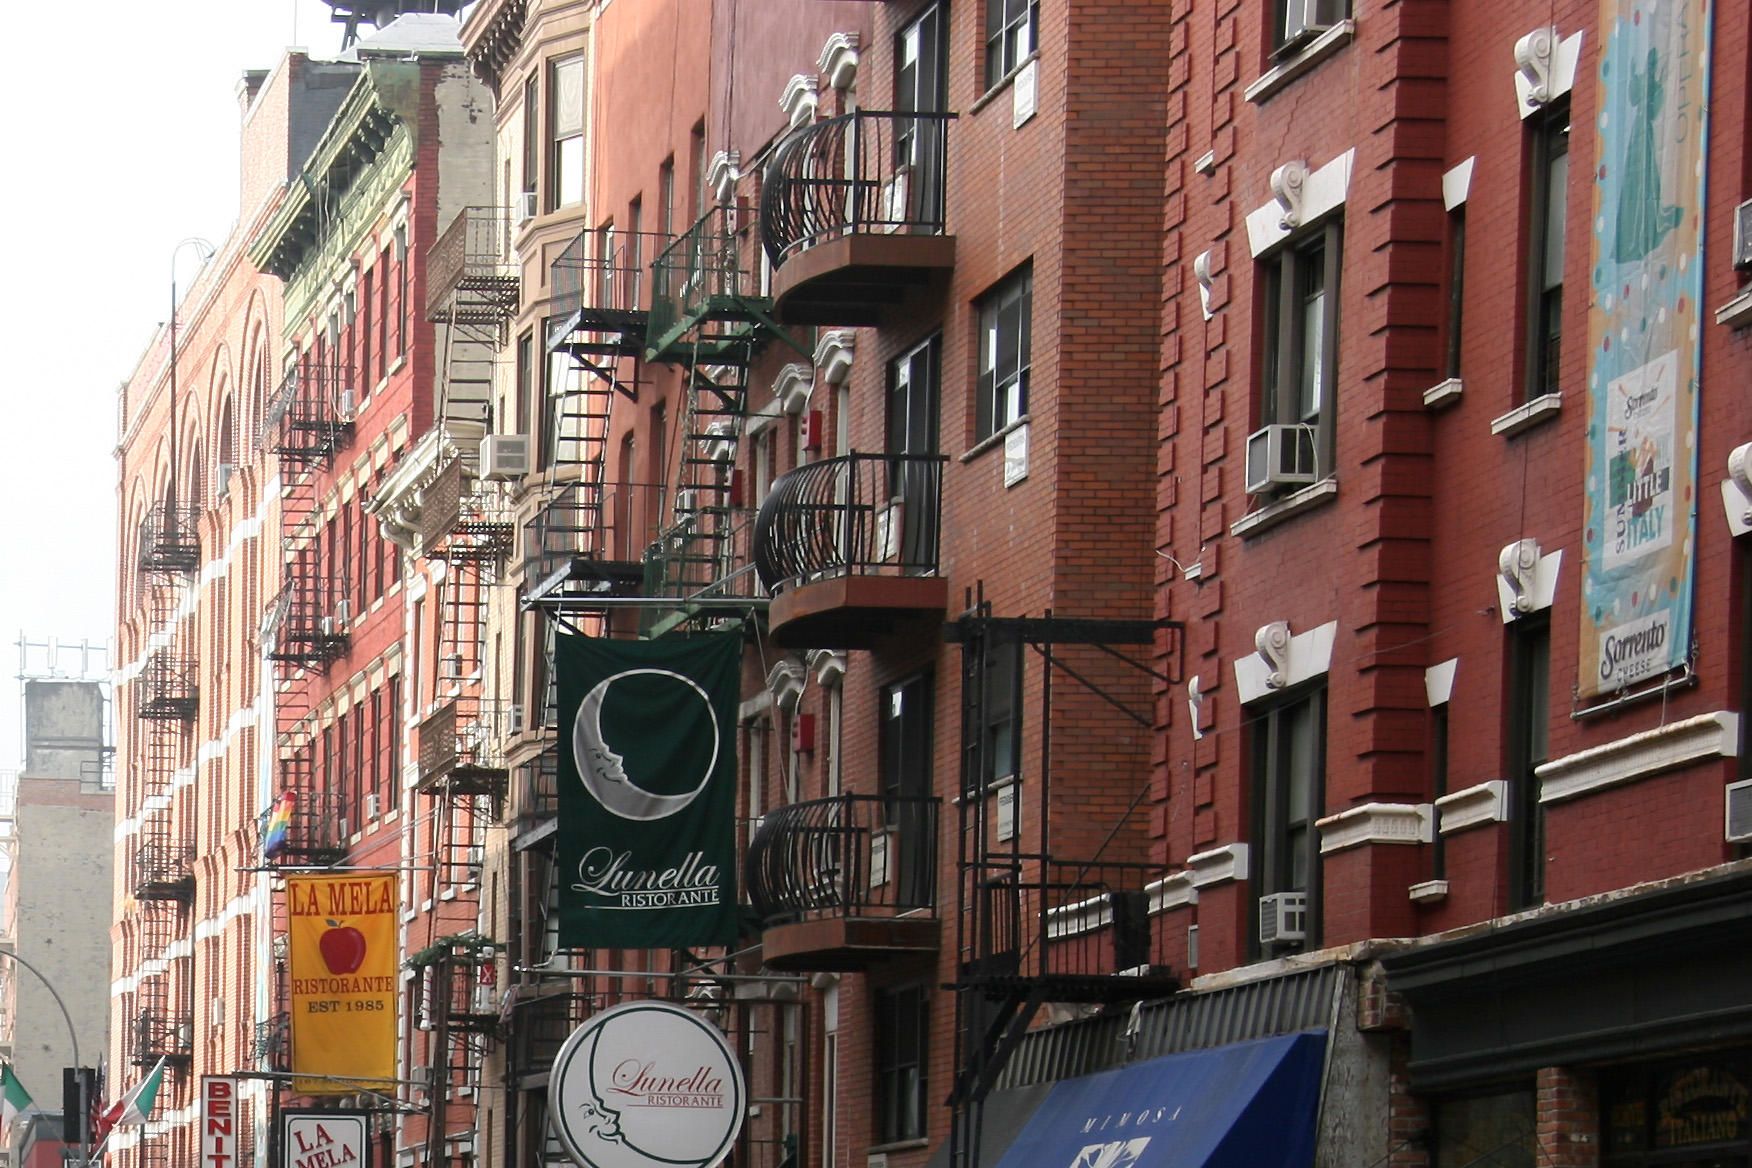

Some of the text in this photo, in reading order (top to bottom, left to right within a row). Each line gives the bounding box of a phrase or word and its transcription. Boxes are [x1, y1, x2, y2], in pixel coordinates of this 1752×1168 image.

[1626, 472, 1664, 509] LITTLE
[1627, 504, 1666, 551] ITALY
[1601, 620, 1666, 680] Sorrento
[571, 846, 721, 897] Lunella
[289, 880, 393, 916] LA MELA
[622, 888, 720, 907] RISTORANTE
[294, 976, 394, 996] RISTORANTE
[308, 1000, 385, 1014] EST 1985
[607, 1057, 723, 1097] Lunella
[648, 1095, 723, 1108] RISTORANTE
[1079, 1107, 1184, 1134] MIMOSA
[293, 1123, 335, 1155] LA
